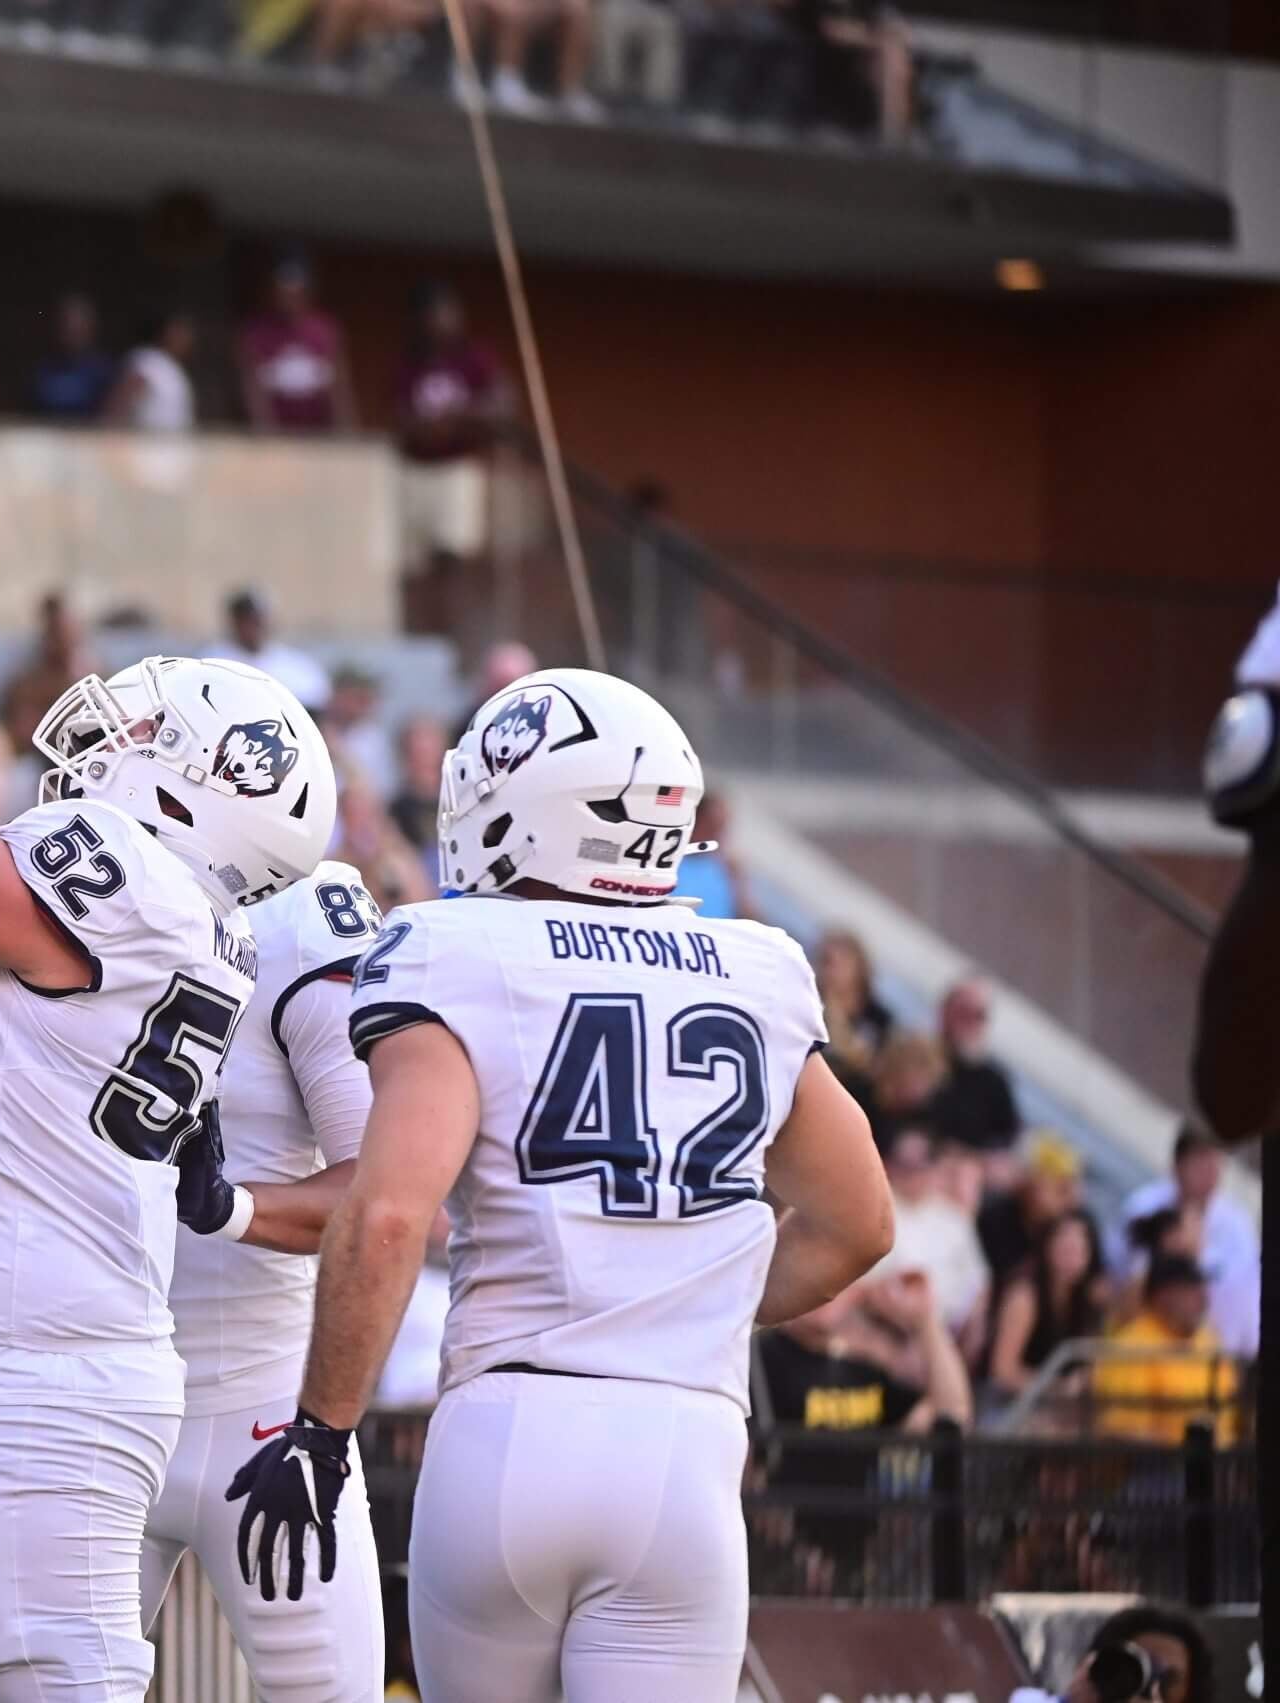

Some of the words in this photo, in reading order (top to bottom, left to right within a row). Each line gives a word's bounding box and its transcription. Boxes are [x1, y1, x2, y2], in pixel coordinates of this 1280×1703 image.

[30, 813, 127, 922] 52
[624, 829, 682, 868] 42
[352, 921, 412, 996] 2
[545, 919, 682, 971] BURTON
[684, 931, 731, 979] JR.
[89, 971, 245, 1166] 5
[516, 993, 771, 1218] 42
